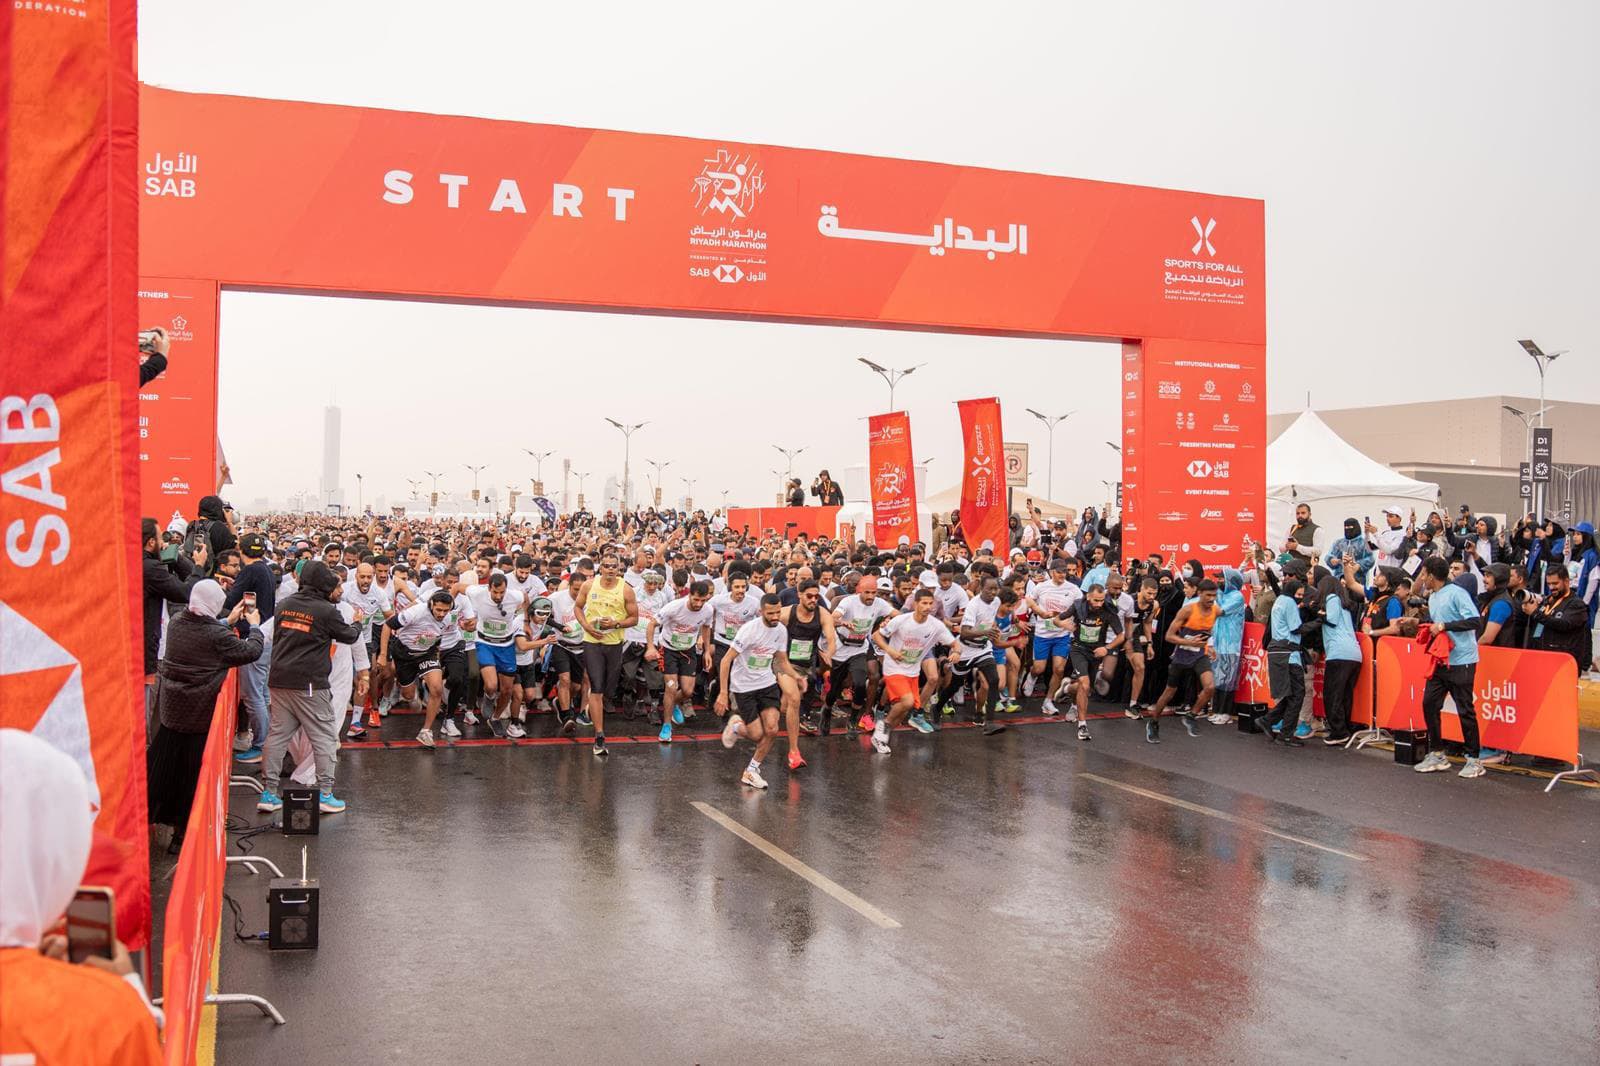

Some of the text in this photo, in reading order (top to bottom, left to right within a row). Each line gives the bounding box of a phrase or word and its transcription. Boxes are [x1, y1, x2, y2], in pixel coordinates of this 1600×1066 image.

[145, 177, 196, 198] SAB
[382, 169, 635, 222] START
[818, 205, 1028, 260] البداية
[690, 237, 767, 250] RIYADH MARATHON
[689, 267, 710, 277] SAB
[1165, 259, 1244, 274] SPORTS FOR ALL
[1174, 360, 1240, 370] INSTITUTIONAL PARTNERS
[1158, 384, 1181, 394] 2030
[1537, 437, 1548, 445] D1
[1213, 469, 1229, 478] SAB
[0, 393, 71, 568] SAB
[1204, 489, 1230, 497] PARTNERS
[1482, 703, 1516, 724] SAB
